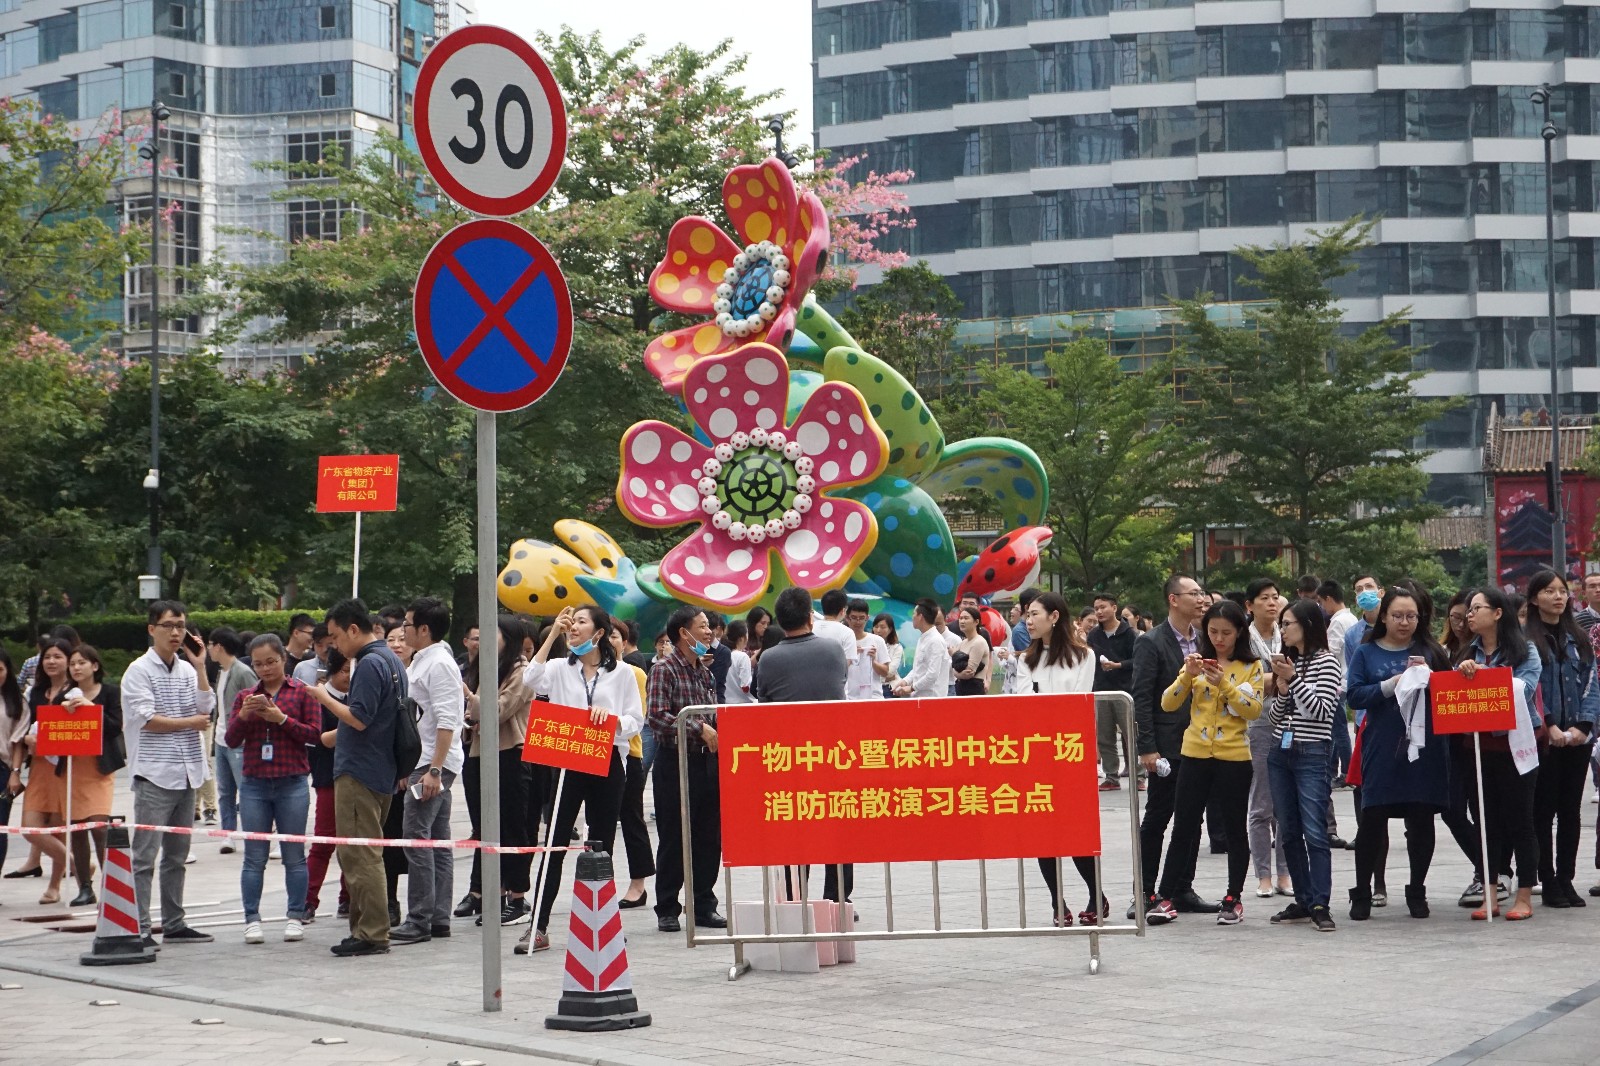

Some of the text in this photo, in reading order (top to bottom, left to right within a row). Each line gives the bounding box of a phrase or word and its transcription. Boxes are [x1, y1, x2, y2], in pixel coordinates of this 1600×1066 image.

[448, 78, 534, 170] 30
[323, 466, 393, 478] 广东省物资产业
[337, 490, 377, 501] 有限公司
[1436, 686, 1509, 702] 广东广物国际贸
[1437, 700, 1510, 715] 易集团有限公司
[48, 731, 90, 741] 理有限公司
[531, 717, 611, 744] 广东省广物控
[528, 732, 608, 760] 股集团有限公
[731, 732, 1085, 774] 广物中心暨保利中达广场
[764, 782, 1055, 822] 消防疏散演习集合点
